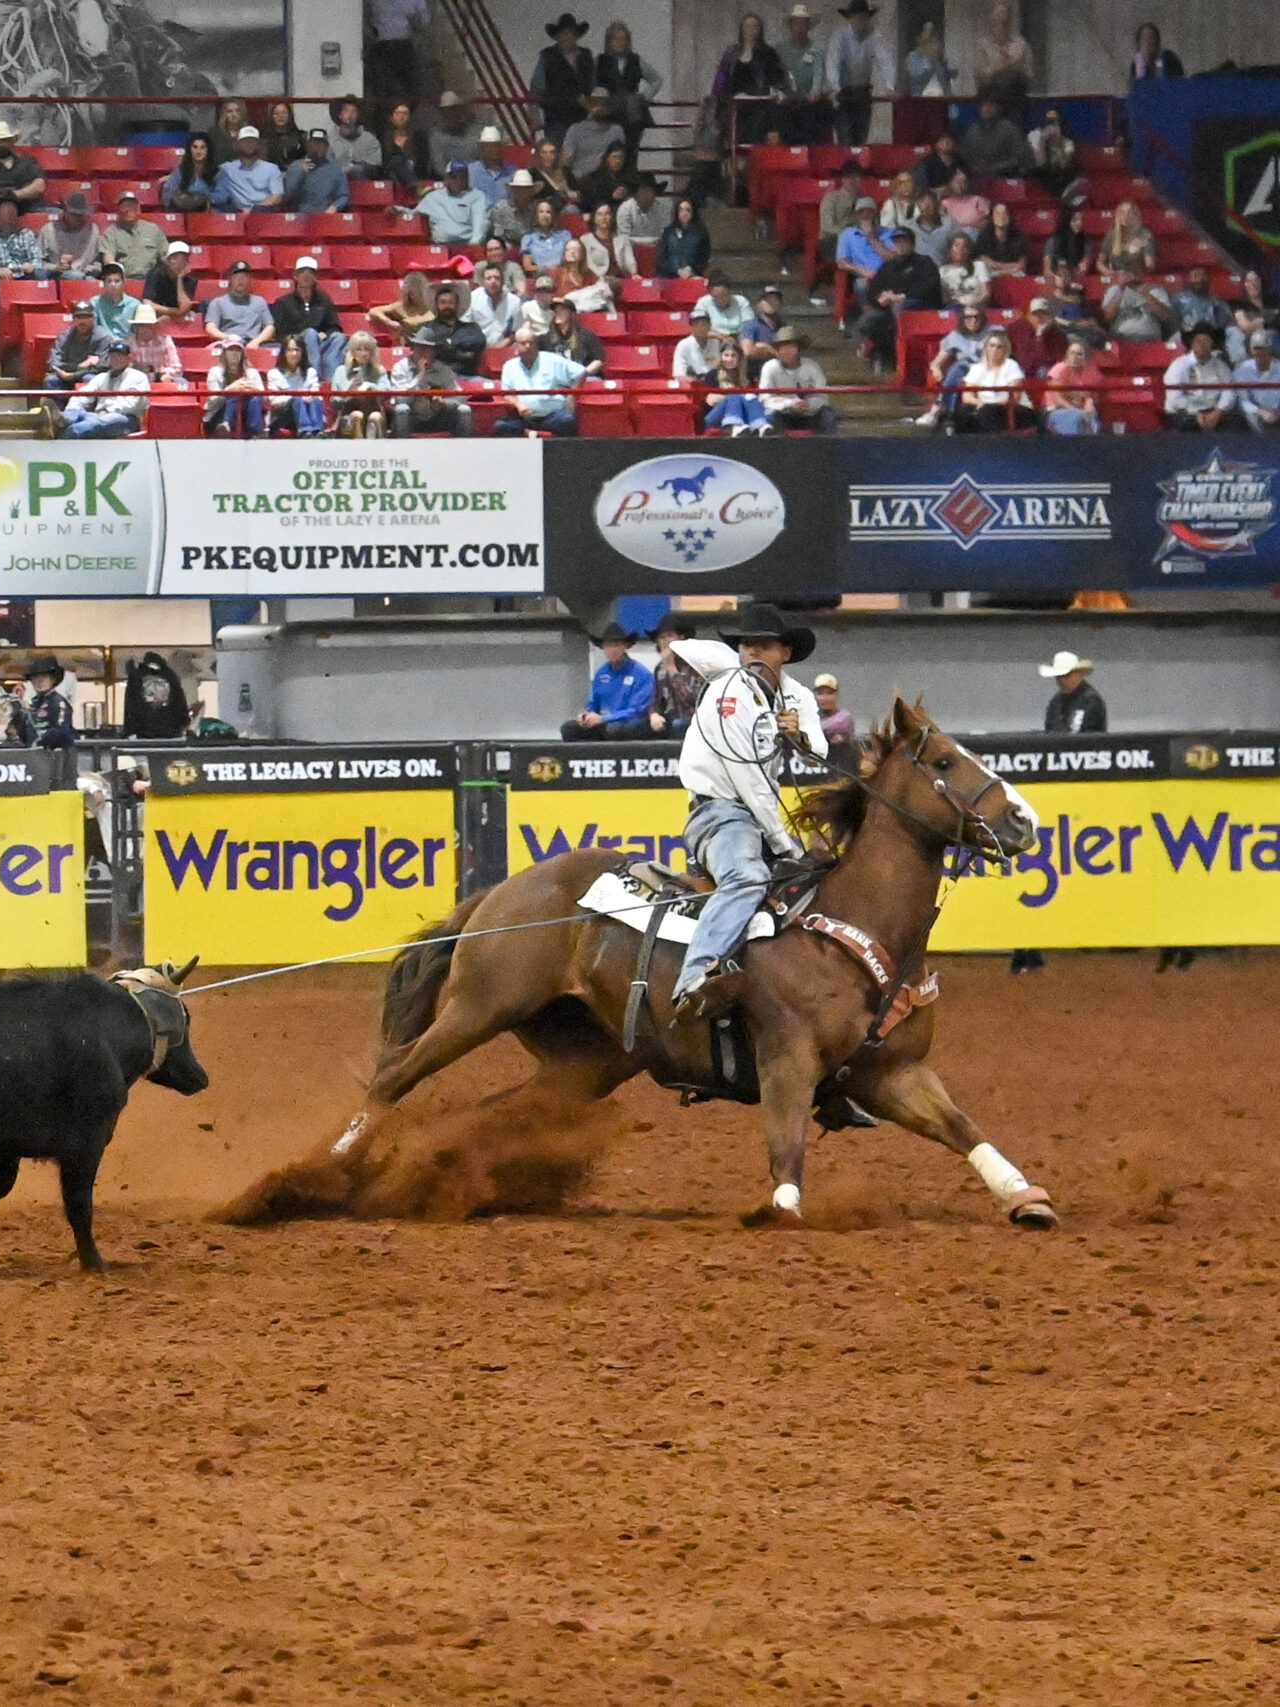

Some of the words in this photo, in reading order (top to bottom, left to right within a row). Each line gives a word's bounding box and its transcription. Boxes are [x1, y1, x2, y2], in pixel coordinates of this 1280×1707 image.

[28, 461, 133, 517] P&K
[292, 469, 427, 491] OFFICIAL
[212, 493, 353, 514] TRACTOR
[360, 491, 508, 512] PROVIDER
[849, 499, 932, 527] LAZY
[1001, 497, 1111, 526] ARENA
[336, 514, 373, 528] LAZY
[390, 514, 441, 527] ARENA
[2, 554, 62, 572] JOHN
[66, 554, 138, 571] DEERE
[181, 543, 540, 573] PKEQUIPMENT.COM
[568, 759, 617, 778] THE
[1047, 750, 1112, 771] LIVES
[1116, 749, 1155, 769] ON.
[1226, 748, 1274, 767] THE
[203, 763, 247, 781] THE
[250, 761, 334, 781] LEGACY
[338, 759, 401, 779] LIVES
[404, 758, 443, 778] ON.
[154, 826, 446, 922] Wrangler
